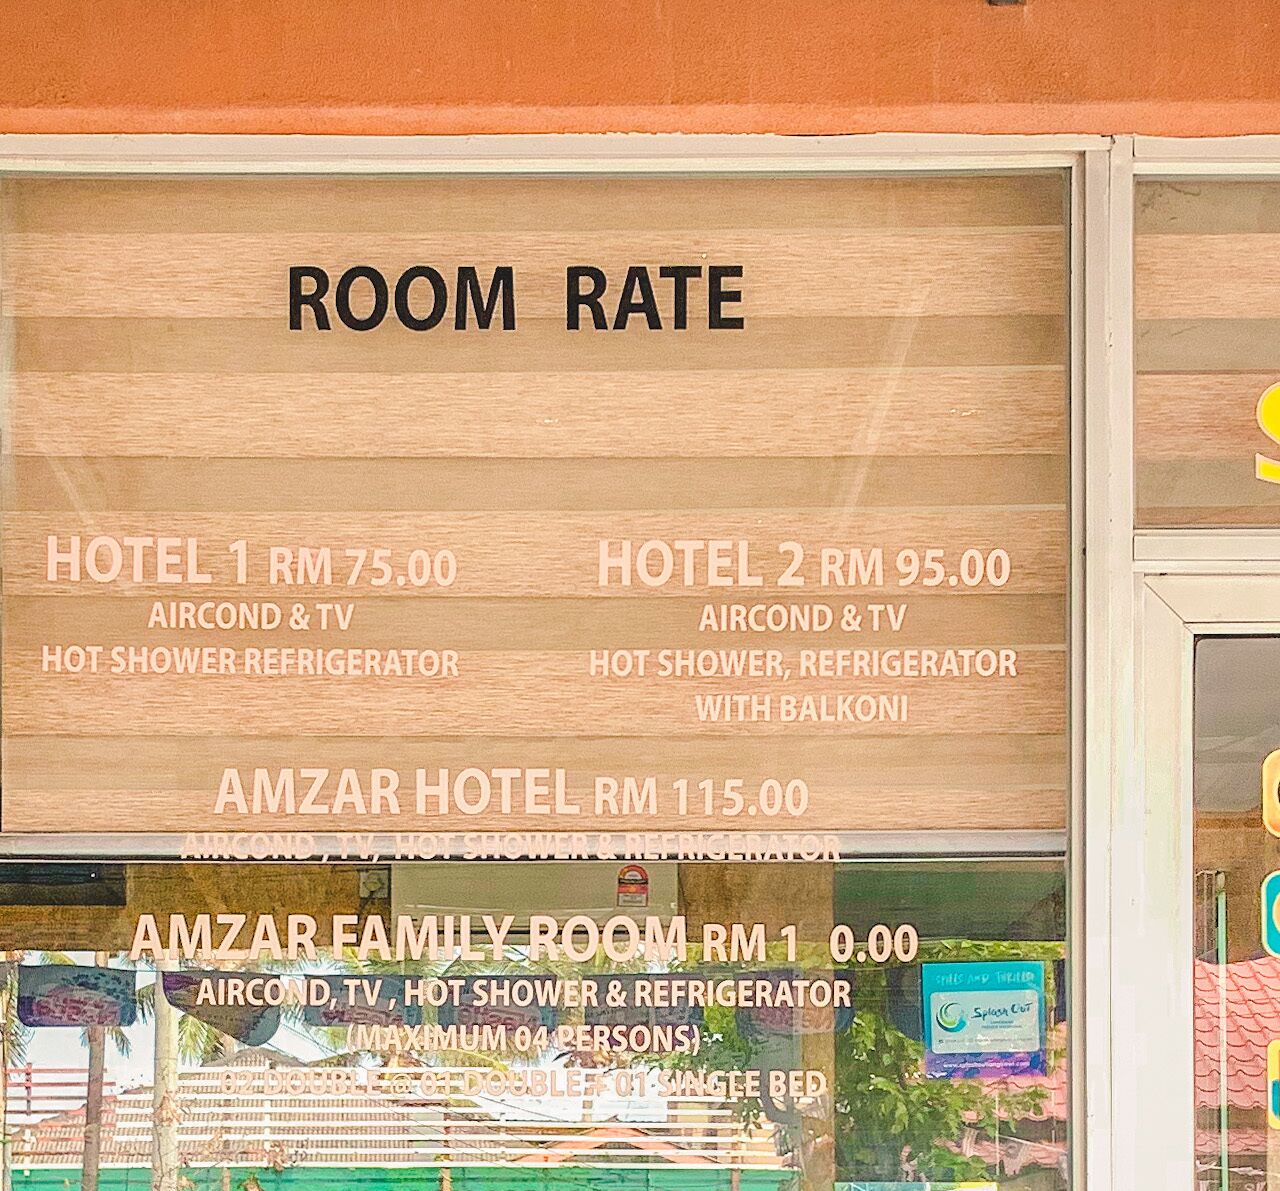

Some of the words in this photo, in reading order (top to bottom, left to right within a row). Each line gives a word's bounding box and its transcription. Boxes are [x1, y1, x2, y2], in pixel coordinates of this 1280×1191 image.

[289, 265, 516, 331] ROOM
[566, 265, 744, 330] RATE
[47, 535, 212, 584] HOTEL
[228, 540, 248, 584] 1
[270, 547, 332, 586] RM
[345, 549, 457, 587] 75.00
[598, 539, 763, 587] HOTEL
[777, 541, 805, 587] 2
[821, 548, 884, 586] RM
[896, 548, 1011, 587] 95.00
[148, 602, 281, 630] AIRCOND
[289, 603, 310, 630] &
[315, 603, 354, 630] TV
[698, 604, 833, 632] AIRCOND
[840, 604, 862, 632] &
[867, 604, 908, 632] TV
[41, 645, 103, 672] HOT
[111, 646, 236, 675] SHOWER
[244, 647, 459, 677] REFRIGERATOR
[589, 649, 649, 677] HOT
[657, 649, 790, 681] SHOWER,
[799, 649, 1018, 678] REFRIGERATOR
[695, 695, 771, 722] WITH
[779, 695, 908, 722] BALKONI
[214, 767, 401, 815] AMZAR
[416, 767, 581, 816] HOTEL
[594, 777, 658, 816] RM
[671, 777, 809, 817] 115.00
[394, 834, 461, 859] HOT
[464, 833, 589, 860] SHOWER
[597, 833, 618, 859] &
[625, 833, 841, 862] REFRIGERATOR
[131, 914, 318, 961] AMZAR
[332, 914, 515, 961] FAMILY
[529, 915, 687, 962] ROOM
[703, 923, 766, 962] RM
[780, 924, 797, 962] 1
[829, 924, 918, 963] 0.00
[196, 979, 337, 1010] AIRCOND,
[405, 980, 466, 1007] HOT
[473, 980, 598, 1008] SHOWER
[605, 980, 627, 1007] &
[635, 980, 852, 1008] REFRIGERATOR
[346, 1023, 507, 1053] (MAXIMUM
[514, 1025, 548, 1052] 04
[557, 1024, 701, 1056] PERSONS)
[221, 1070, 258, 1095] 02
[263, 1070, 381, 1095] DOUBLE
[389, 1072, 414, 1098] @
[420, 1070, 452, 1096] 01
[464, 1070, 581, 1097] DOUBLE
[614, 1070, 646, 1097] 01
[657, 1070, 760, 1097] SINGLE
[769, 1070, 827, 1097] BED
